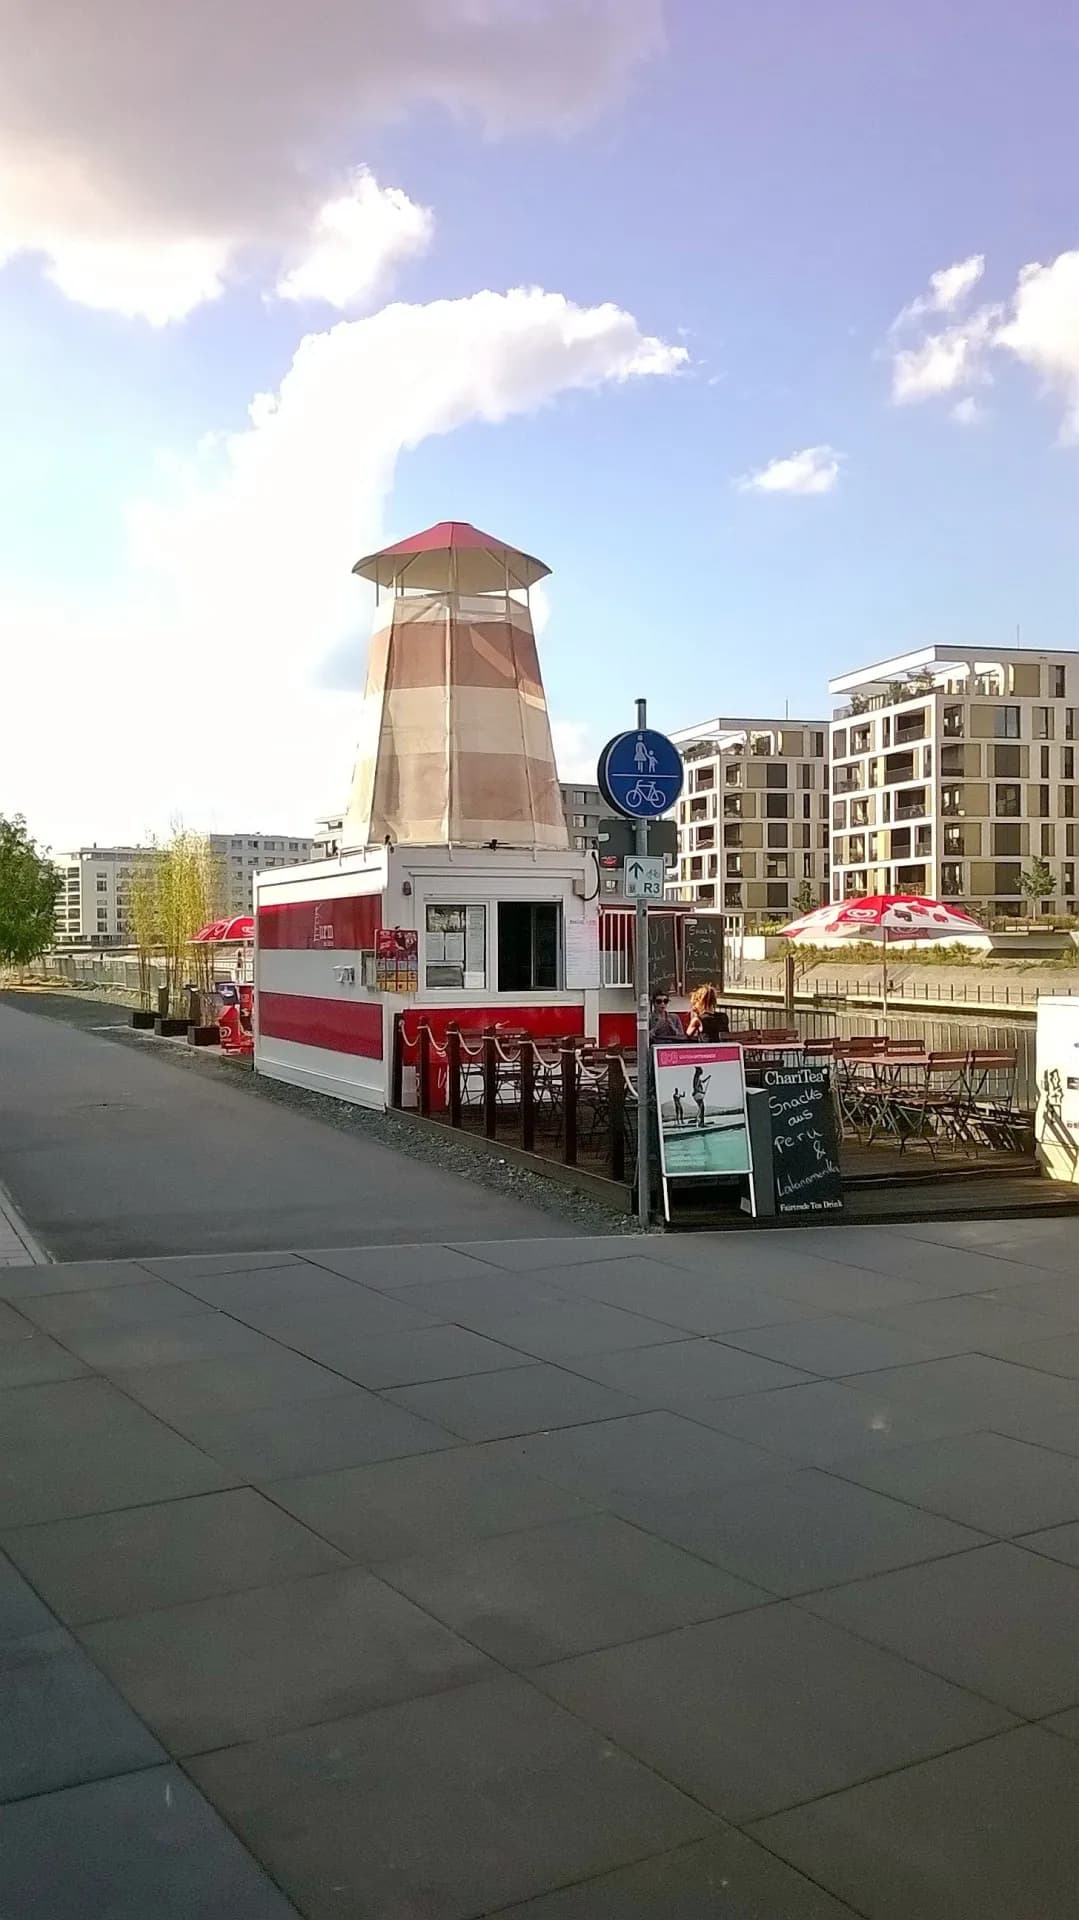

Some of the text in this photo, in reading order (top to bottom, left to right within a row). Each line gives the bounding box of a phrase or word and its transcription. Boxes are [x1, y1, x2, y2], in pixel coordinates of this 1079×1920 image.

[643, 882, 660, 894] R3
[764, 1068, 825, 1086] ChariTea
[768, 1088, 823, 1117] Snacks
[787, 1109, 814, 1127] aus
[774, 1127, 824, 1154] Peru
[813, 1140, 827, 1160] &
[823, 1199, 843, 1209] Drink
